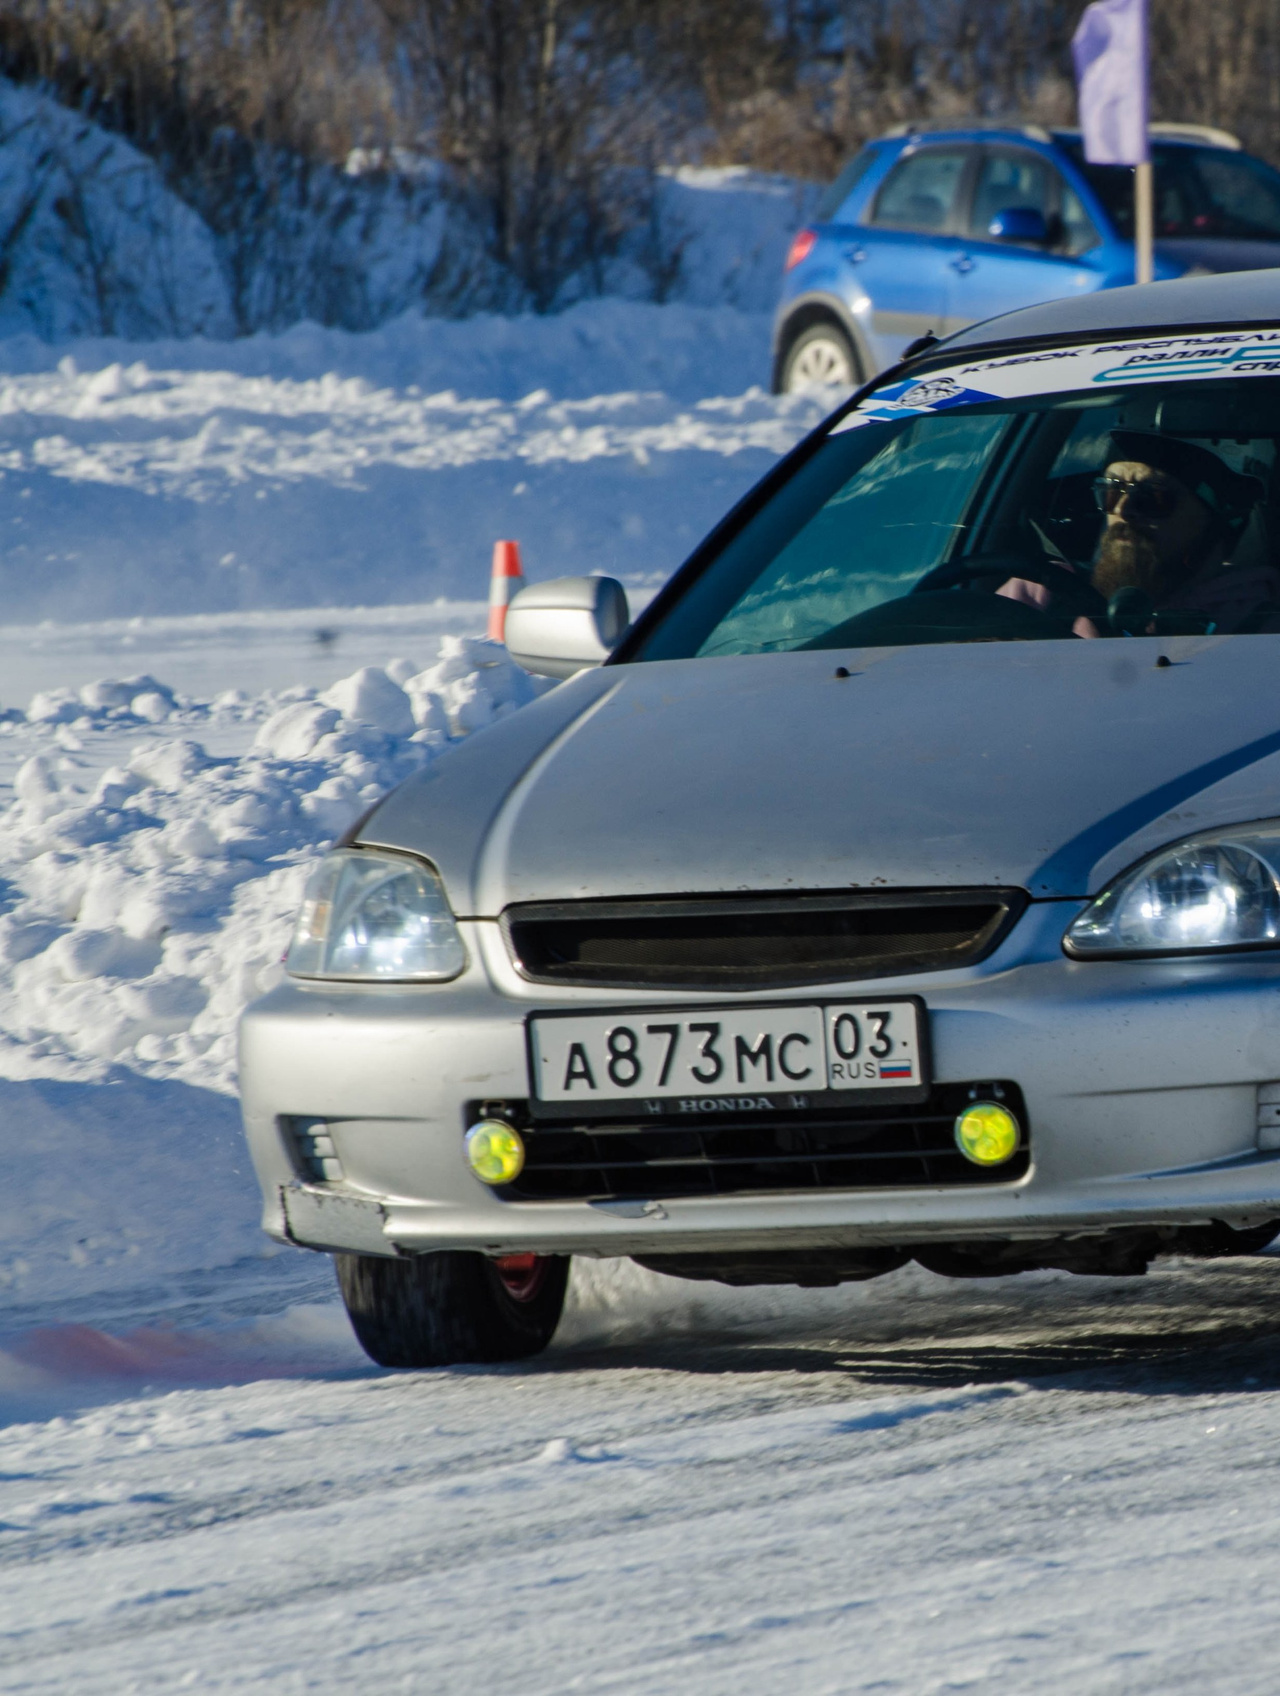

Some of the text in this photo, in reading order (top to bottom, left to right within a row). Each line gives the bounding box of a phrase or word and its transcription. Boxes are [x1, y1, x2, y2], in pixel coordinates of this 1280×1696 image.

[960, 350, 1085, 374] КУБОК
[1123, 347, 1232, 366] ралли
[832, 1010, 893, 1061] 03
[831, 1062, 876, 1080] RUS
[679, 1097, 776, 1113] HONDA
